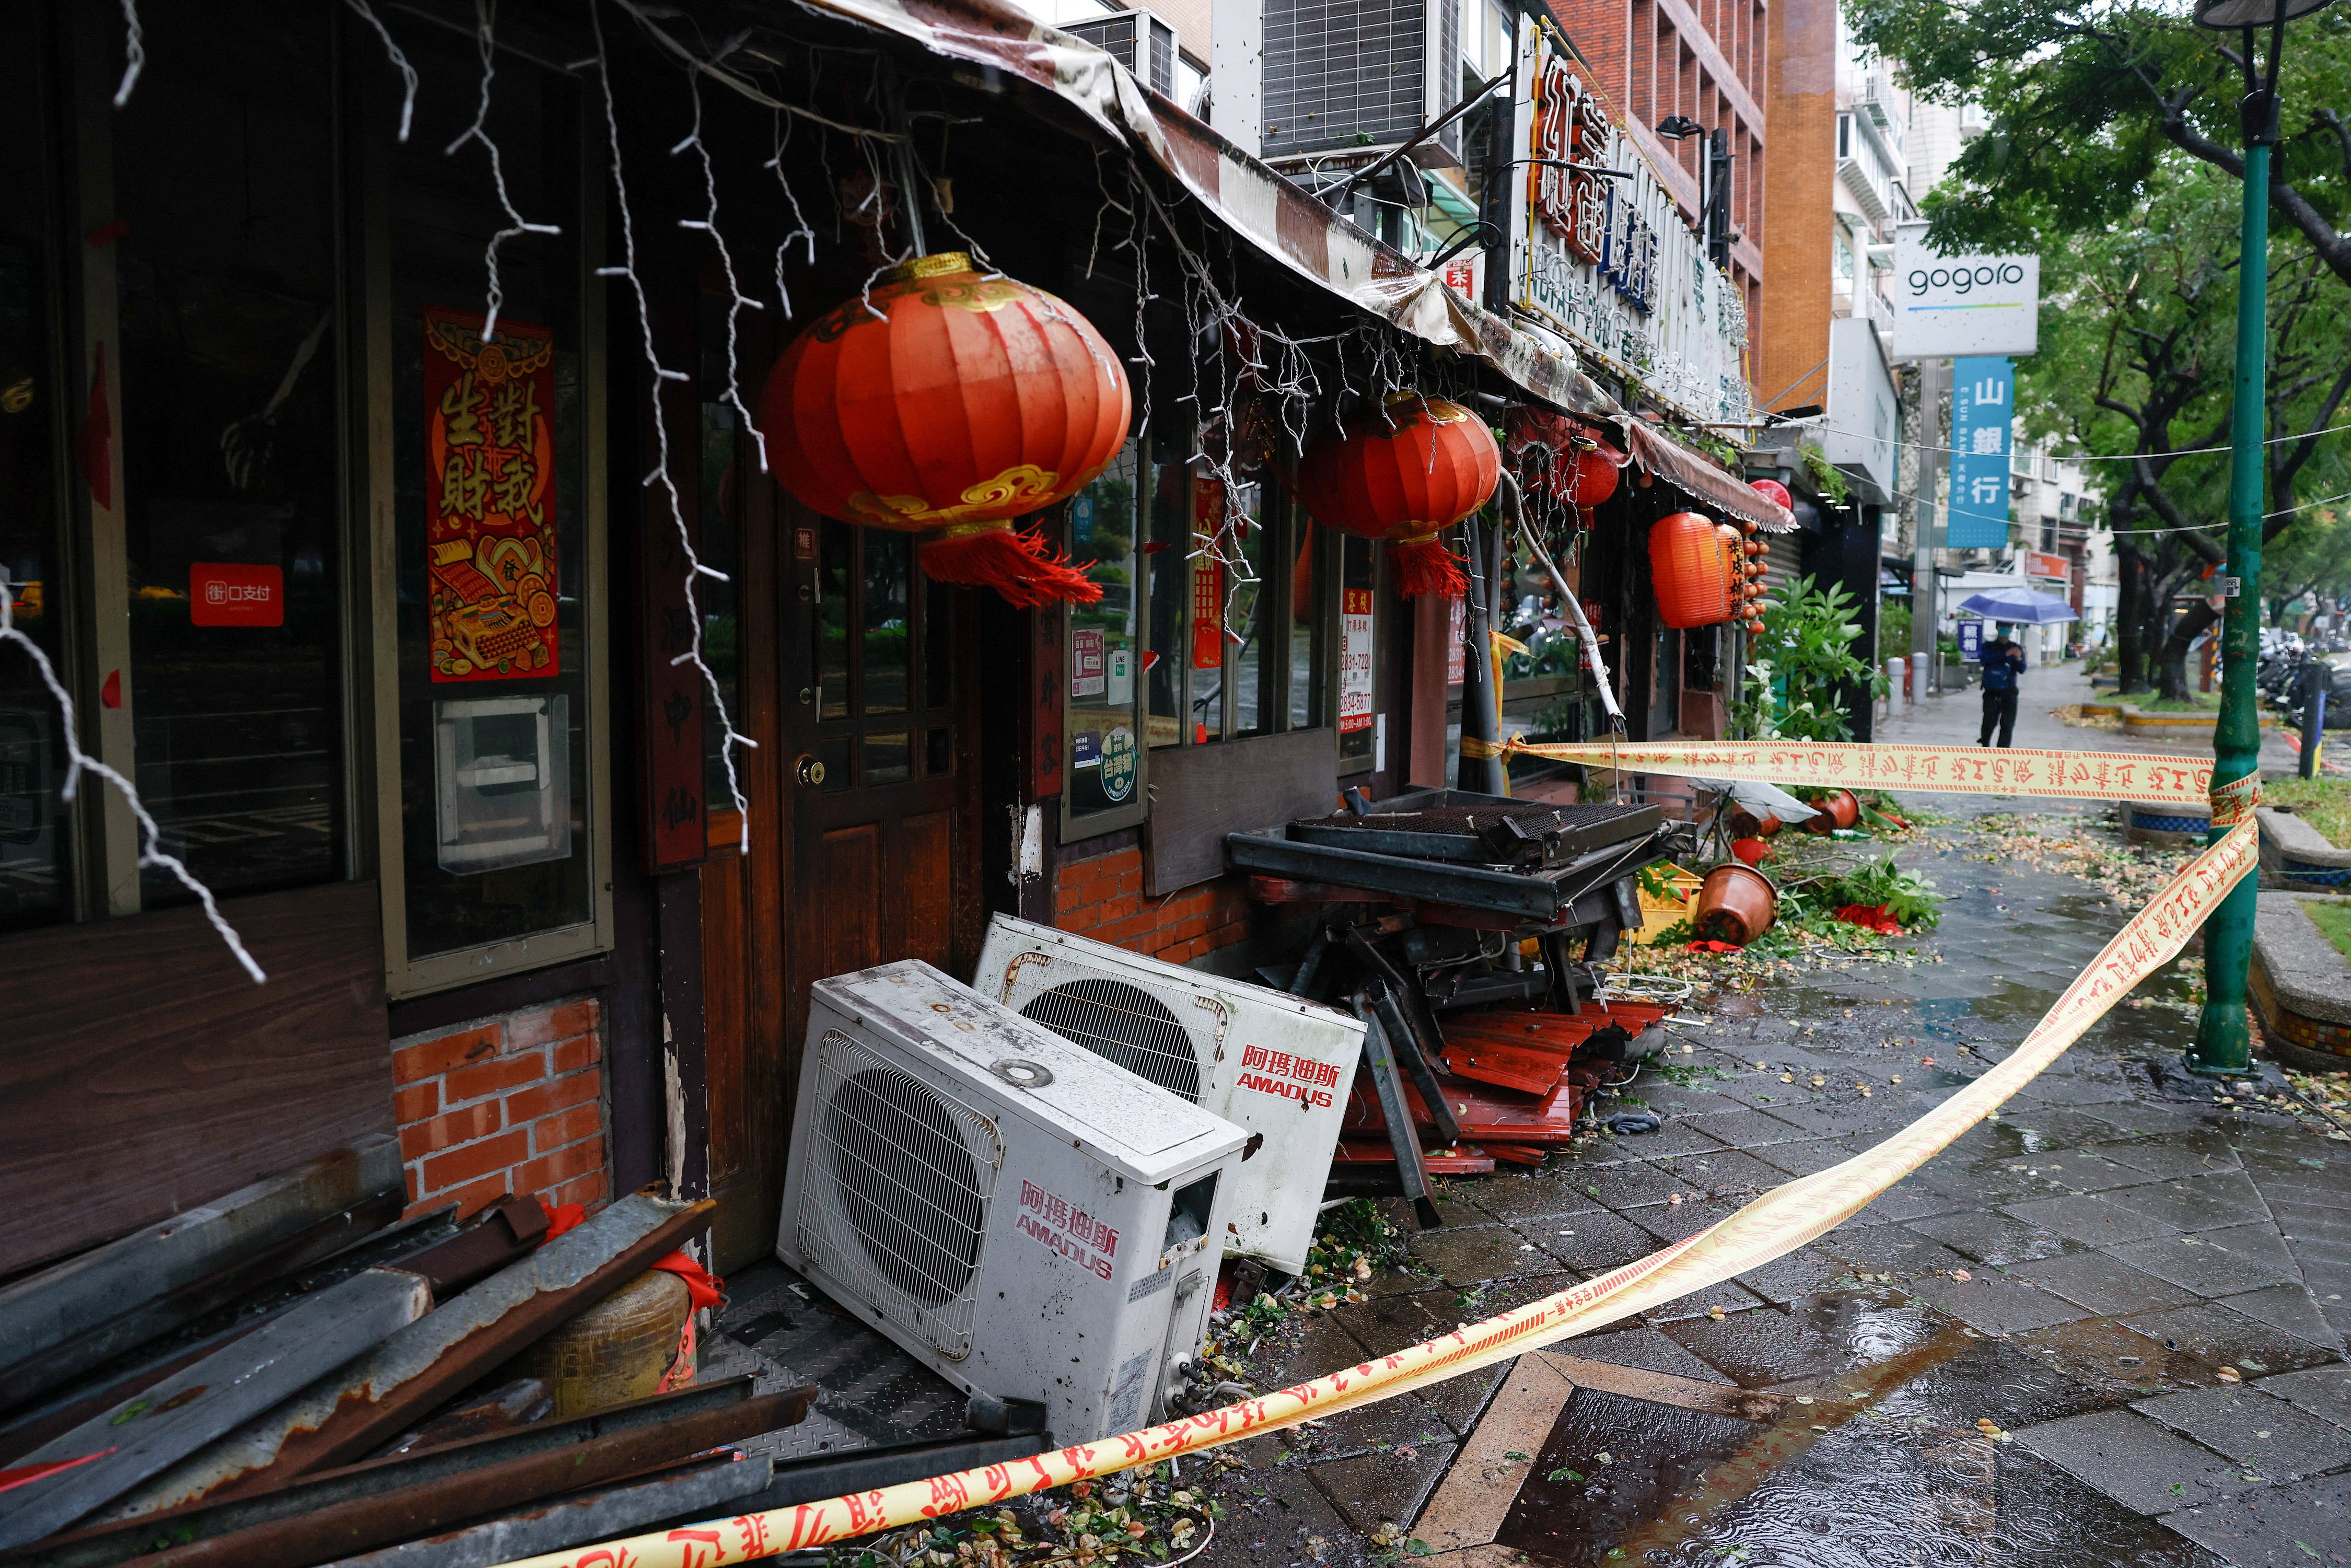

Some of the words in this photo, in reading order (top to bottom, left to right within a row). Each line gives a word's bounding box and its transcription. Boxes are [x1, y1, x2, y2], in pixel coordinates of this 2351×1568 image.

[1908, 262, 2024, 296] gogoro
[1971, 377, 2004, 504] 山銀行
[208, 585, 271, 601] 街口支付
[1348, 590, 1368, 613] 客棧
[1114, 743, 1122, 753] 使用
[1108, 785, 1121, 797] TAIWAN
[1121, 779, 1131, 795] PORK
[1241, 1044, 1342, 1089] 阿瑪迪斯
[1237, 1072, 1334, 1109] AMADUS
[1019, 1178, 1120, 1259] 阿瑪迪斯
[1015, 1213, 1113, 1283] AMADUS
